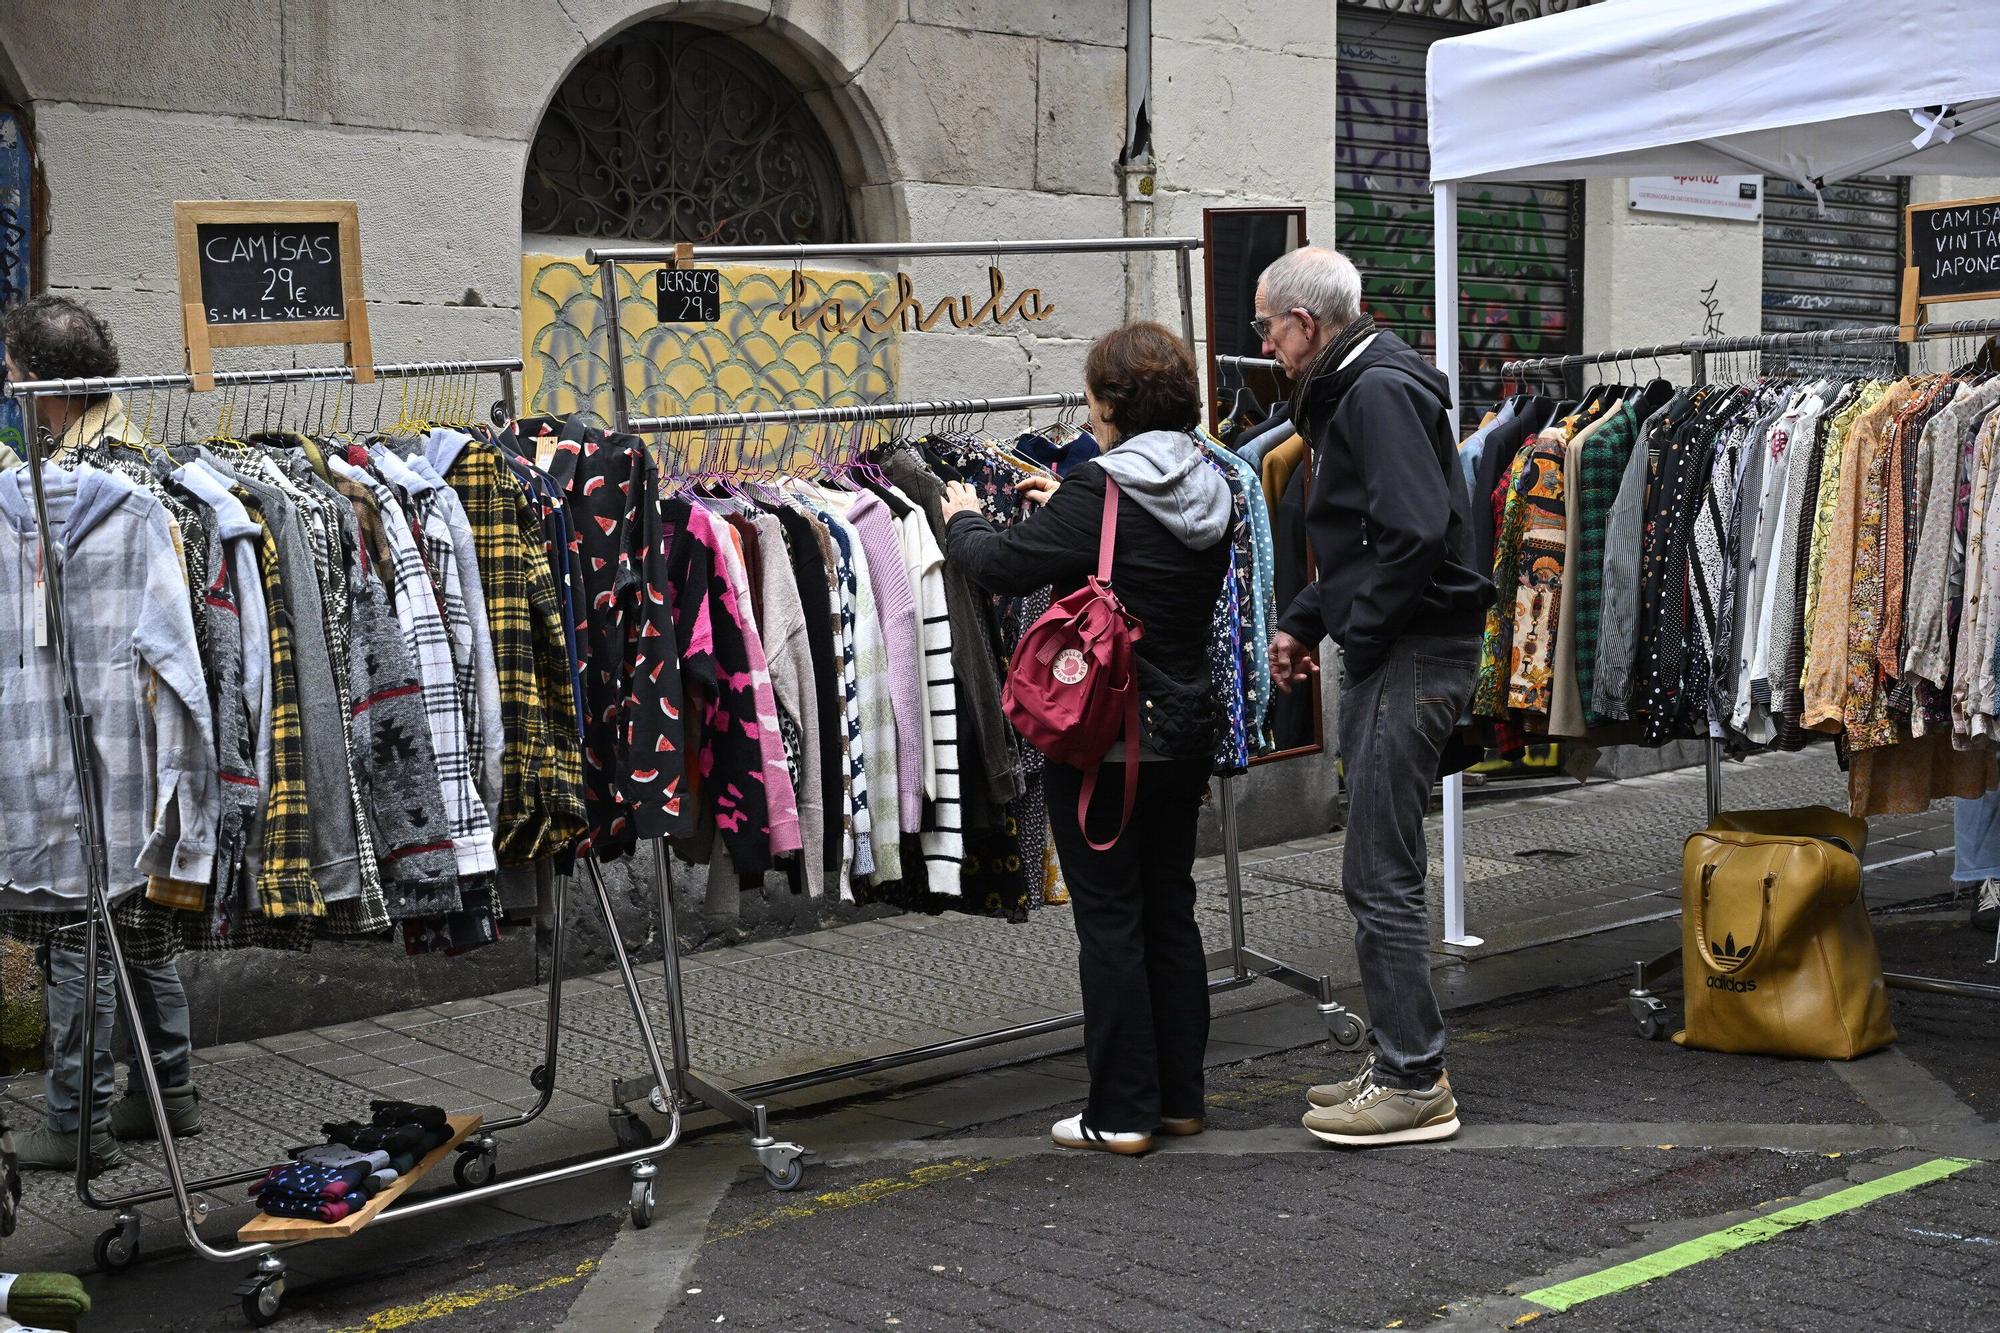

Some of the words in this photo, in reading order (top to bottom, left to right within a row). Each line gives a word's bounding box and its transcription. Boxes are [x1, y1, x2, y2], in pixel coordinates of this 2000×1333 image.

[1936, 230, 2000, 252] VINTA
[260, 267, 307, 303] 29€
[659, 271, 719, 294] JERSEYS
[232, 307, 247, 320] M
[260, 307, 272, 320] L
[678, 296, 715, 320] 29€
[1706, 974, 1758, 993] adidas
